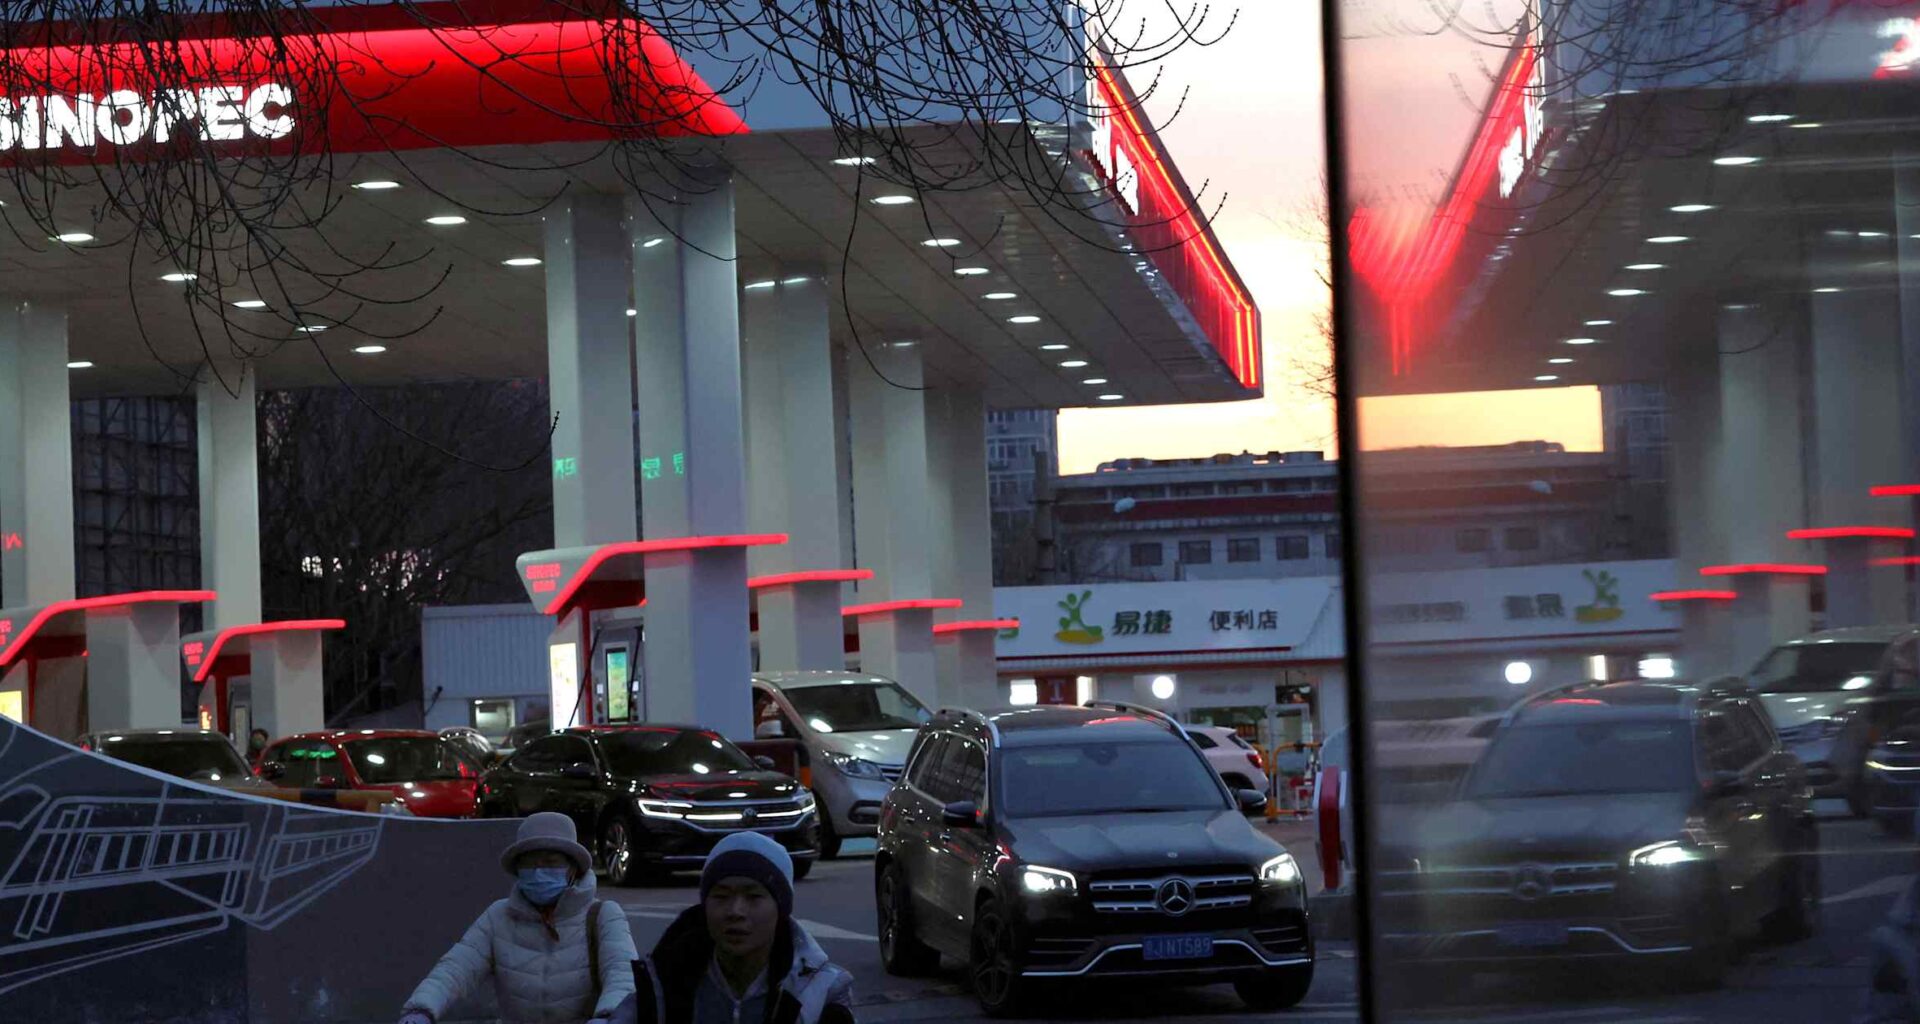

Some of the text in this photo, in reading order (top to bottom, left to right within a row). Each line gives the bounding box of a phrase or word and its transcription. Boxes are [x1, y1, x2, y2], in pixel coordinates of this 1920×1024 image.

[1111, 609, 1278, 635] 易捷 便利店
